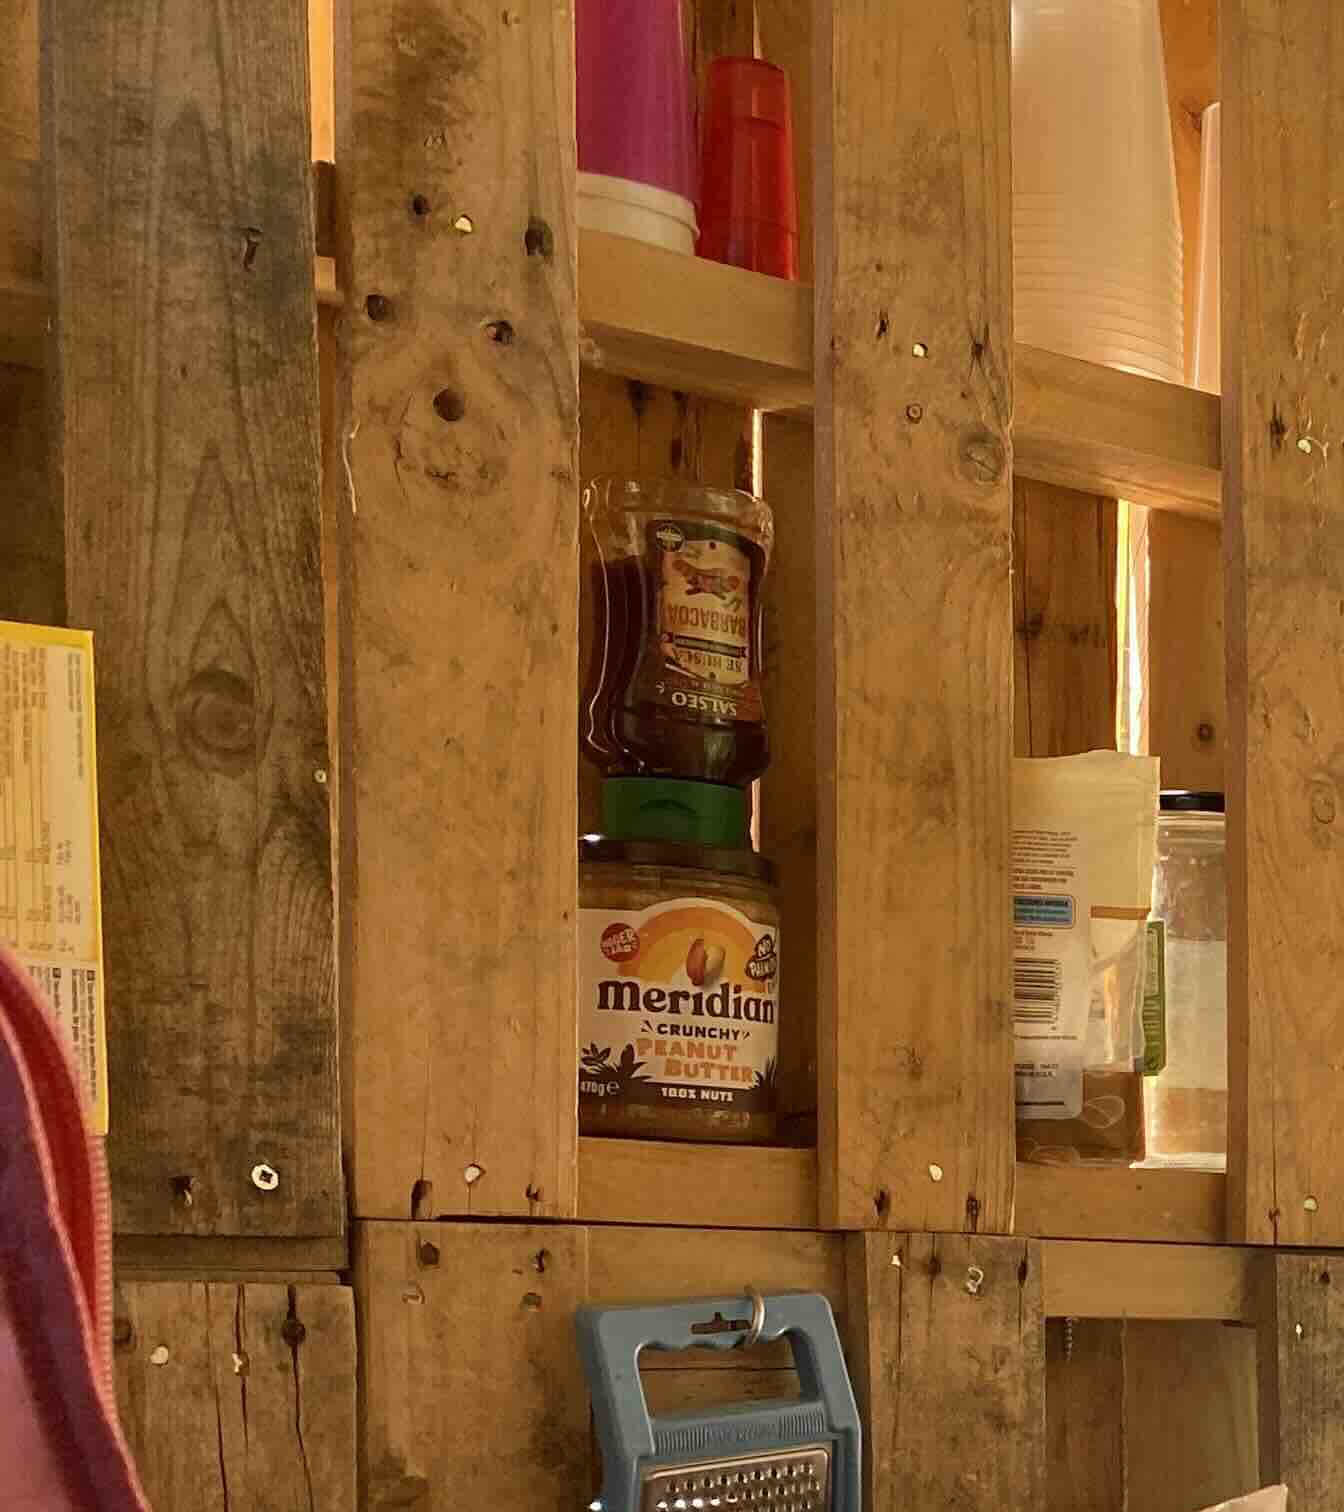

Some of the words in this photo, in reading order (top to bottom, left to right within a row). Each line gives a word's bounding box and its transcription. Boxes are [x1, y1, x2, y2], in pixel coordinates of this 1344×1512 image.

[668, 603, 746, 638] BARBACOA
[671, 690, 737, 716] SALSEO
[596, 980, 775, 1025] meridian
[657, 1023, 741, 1041] CRUNCHY
[634, 1037, 737, 1062] PEANUT
[663, 1058, 752, 1083] BUTTER
[700, 1088, 734, 1102] NUTS
